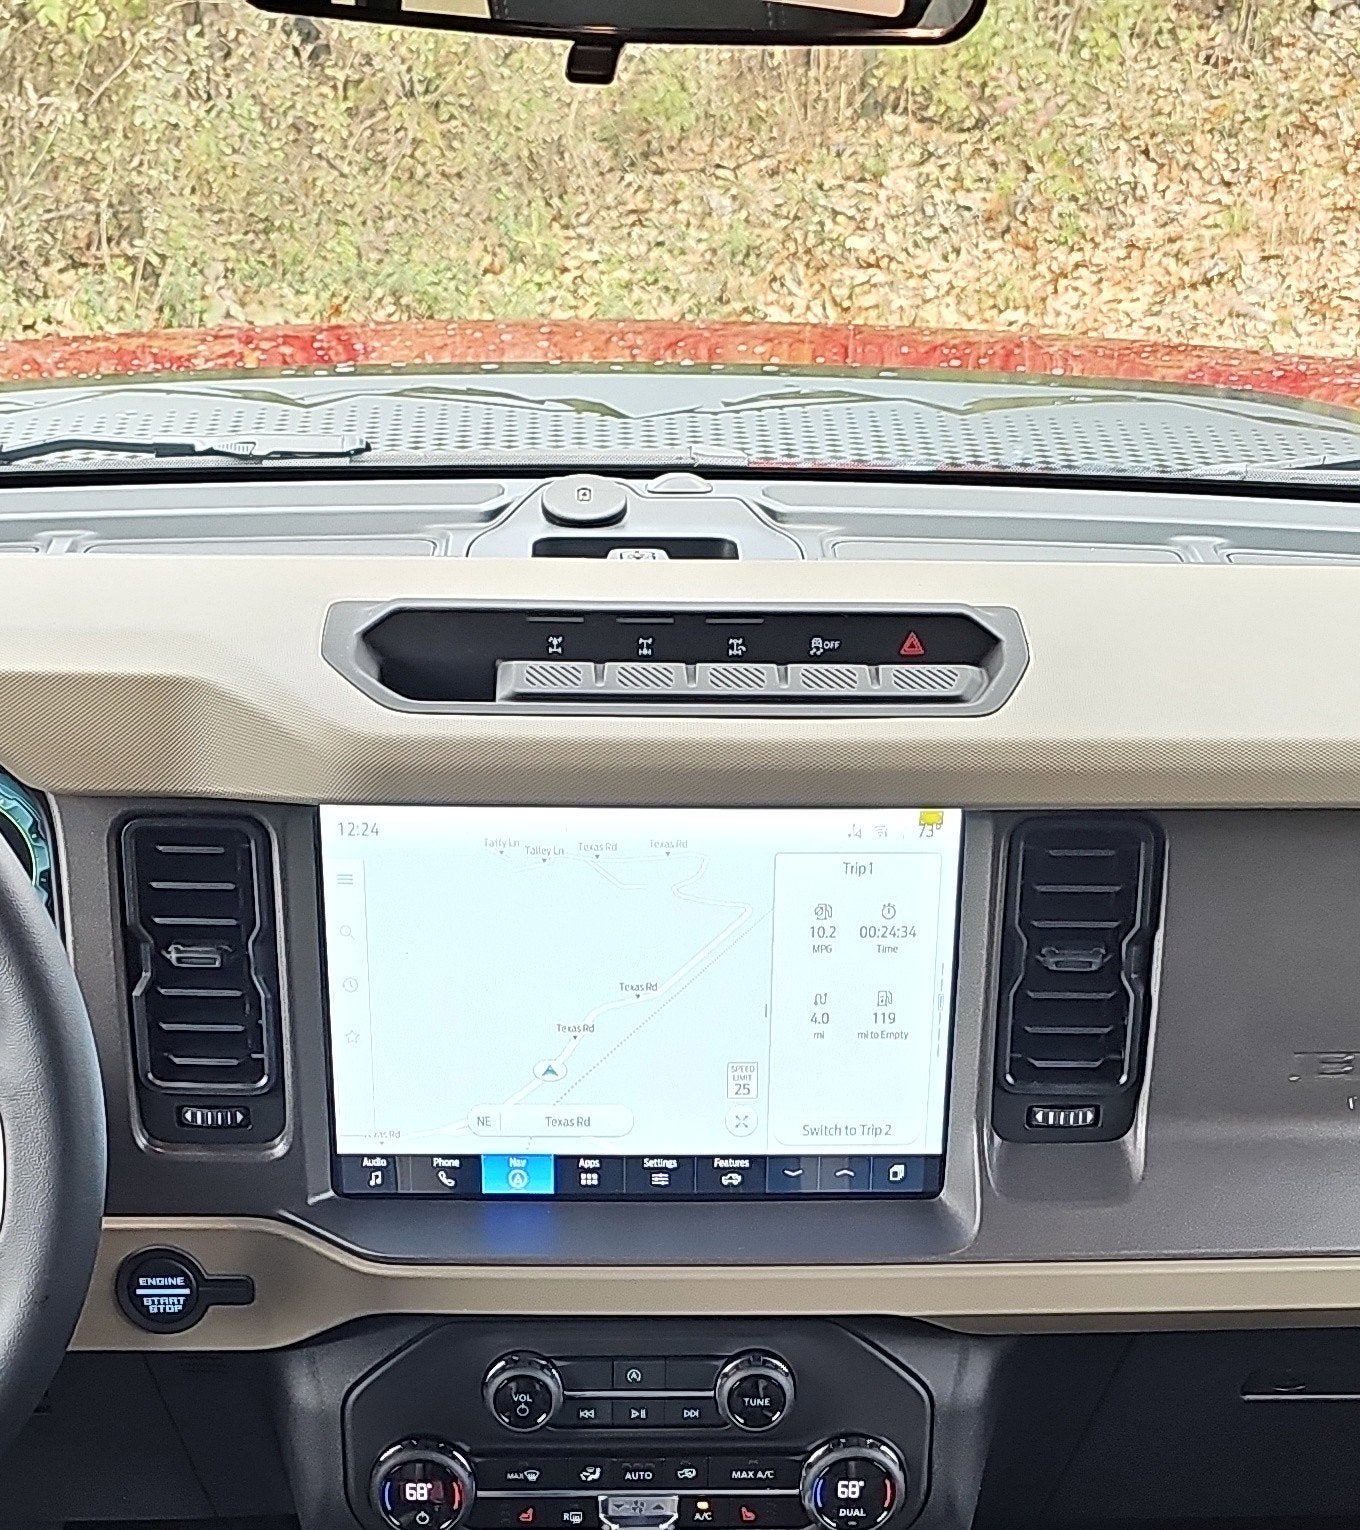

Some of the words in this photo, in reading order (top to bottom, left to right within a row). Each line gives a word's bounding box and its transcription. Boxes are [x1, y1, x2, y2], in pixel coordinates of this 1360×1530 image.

[823, 640, 841, 650] OFF
[337, 822, 380, 838] 12:24
[578, 842, 604, 852] Texas
[605, 842, 618, 852] Rd
[842, 861, 867, 877] Trip
[867, 861, 874, 875] 1
[809, 925, 837, 939] 10.2
[859, 925, 917, 939] 00:24:34
[812, 944, 833, 954] MPG
[877, 944, 899, 954] Time
[619, 982, 644, 992] Texas
[645, 982, 658, 992] Rd
[810, 1012, 830, 1025] 4.0
[872, 1012, 896, 1025] 119
[557, 1024, 582, 1033] Texas
[583, 1024, 595, 1033] Rd
[813, 1030, 825, 1040] mi
[857, 1030, 869, 1040] mi
[870, 1031, 879, 1040] to
[880, 1030, 909, 1041] Empty
[730, 1065, 756, 1074] SPEED
[732, 1074, 752, 1082] LIMIT
[734, 1083, 751, 1096] 25
[477, 1116, 492, 1128] NE
[545, 1116, 574, 1128] Texas
[576, 1116, 591, 1128] Rd
[802, 1124, 842, 1137] Switch
[845, 1125, 857, 1137] to
[860, 1124, 883, 1138] Trip
[884, 1124, 892, 1137] 2
[363, 1157, 387, 1167] Audio
[433, 1157, 460, 1167] Phone
[509, 1158, 527, 1168] Nav
[578, 1158, 600, 1169] Apps
[643, 1158, 677, 1169] Settings
[714, 1158, 749, 1168] Features
[138, 1277, 185, 1286] ENGINE
[143, 1297, 186, 1306] START
[149, 1305, 183, 1314] STOP
[513, 1394, 532, 1403] VOL
[743, 1397, 771, 1407] TUNE
[507, 1472, 524, 1480] MAX
[624, 1471, 653, 1480] AUTO
[731, 1470, 754, 1479] MAX
[755, 1470, 775, 1480] A/C
[405, 1482, 433, 1501] 68°
[837, 1480, 865, 1499] 68°
[694, 1511, 713, 1521] A/C
[839, 1508, 867, 1517] DUAL
